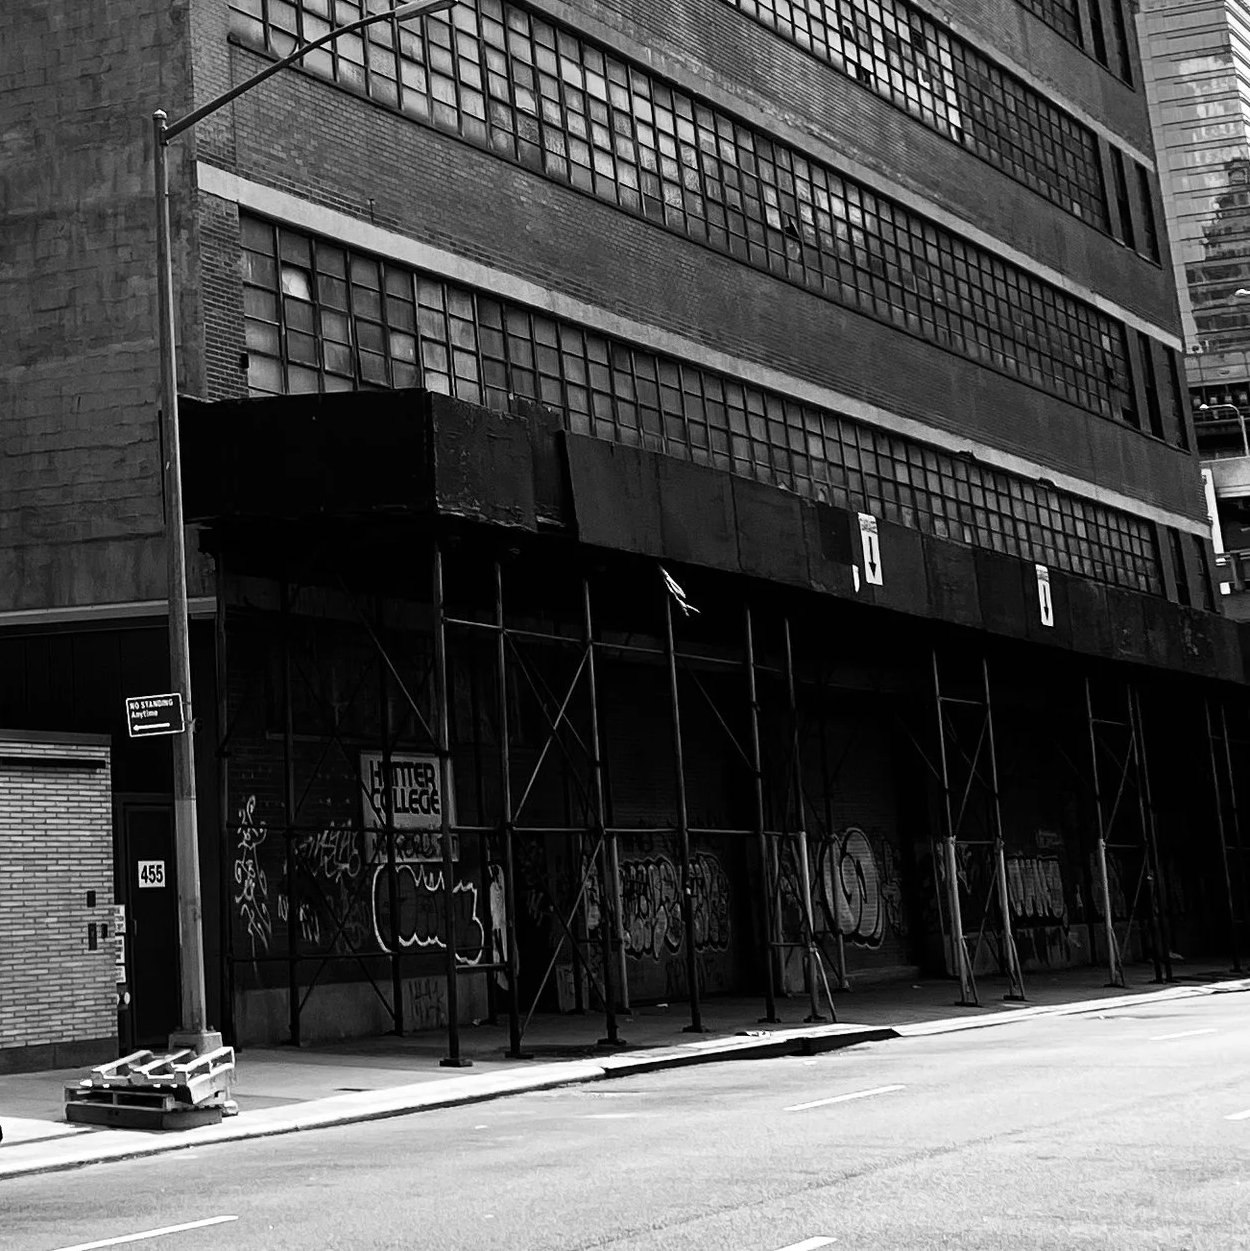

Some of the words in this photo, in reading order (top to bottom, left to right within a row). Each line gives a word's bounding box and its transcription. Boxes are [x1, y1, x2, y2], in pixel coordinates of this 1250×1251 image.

[130, 702, 140, 710] NO
[141, 699, 173, 709] STANDING
[369, 760, 436, 790] HNTER
[141, 865, 163, 883] 455
